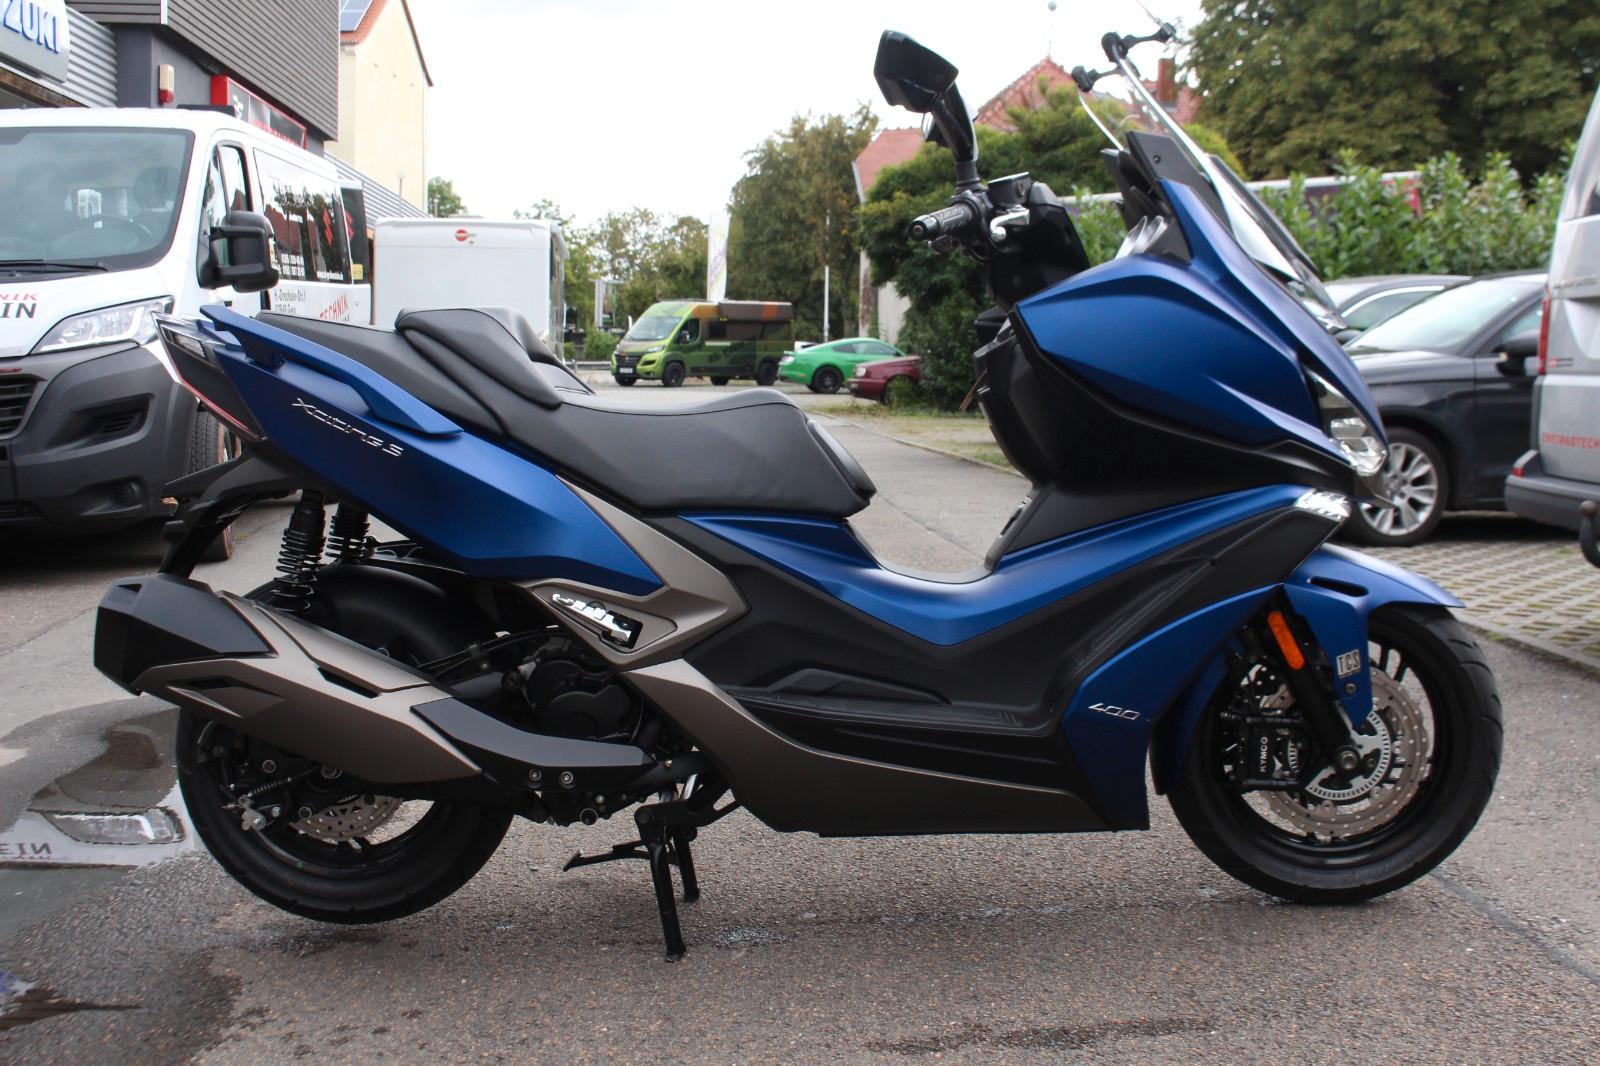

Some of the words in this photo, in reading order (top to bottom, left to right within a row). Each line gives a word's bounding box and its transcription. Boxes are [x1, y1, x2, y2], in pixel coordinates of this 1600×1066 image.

[3, 0, 60, 54] ZUKI
[1337, 650, 1360, 676] TCS
[1087, 702, 1141, 720] 400
[1259, 736, 1269, 773] KYMCO
